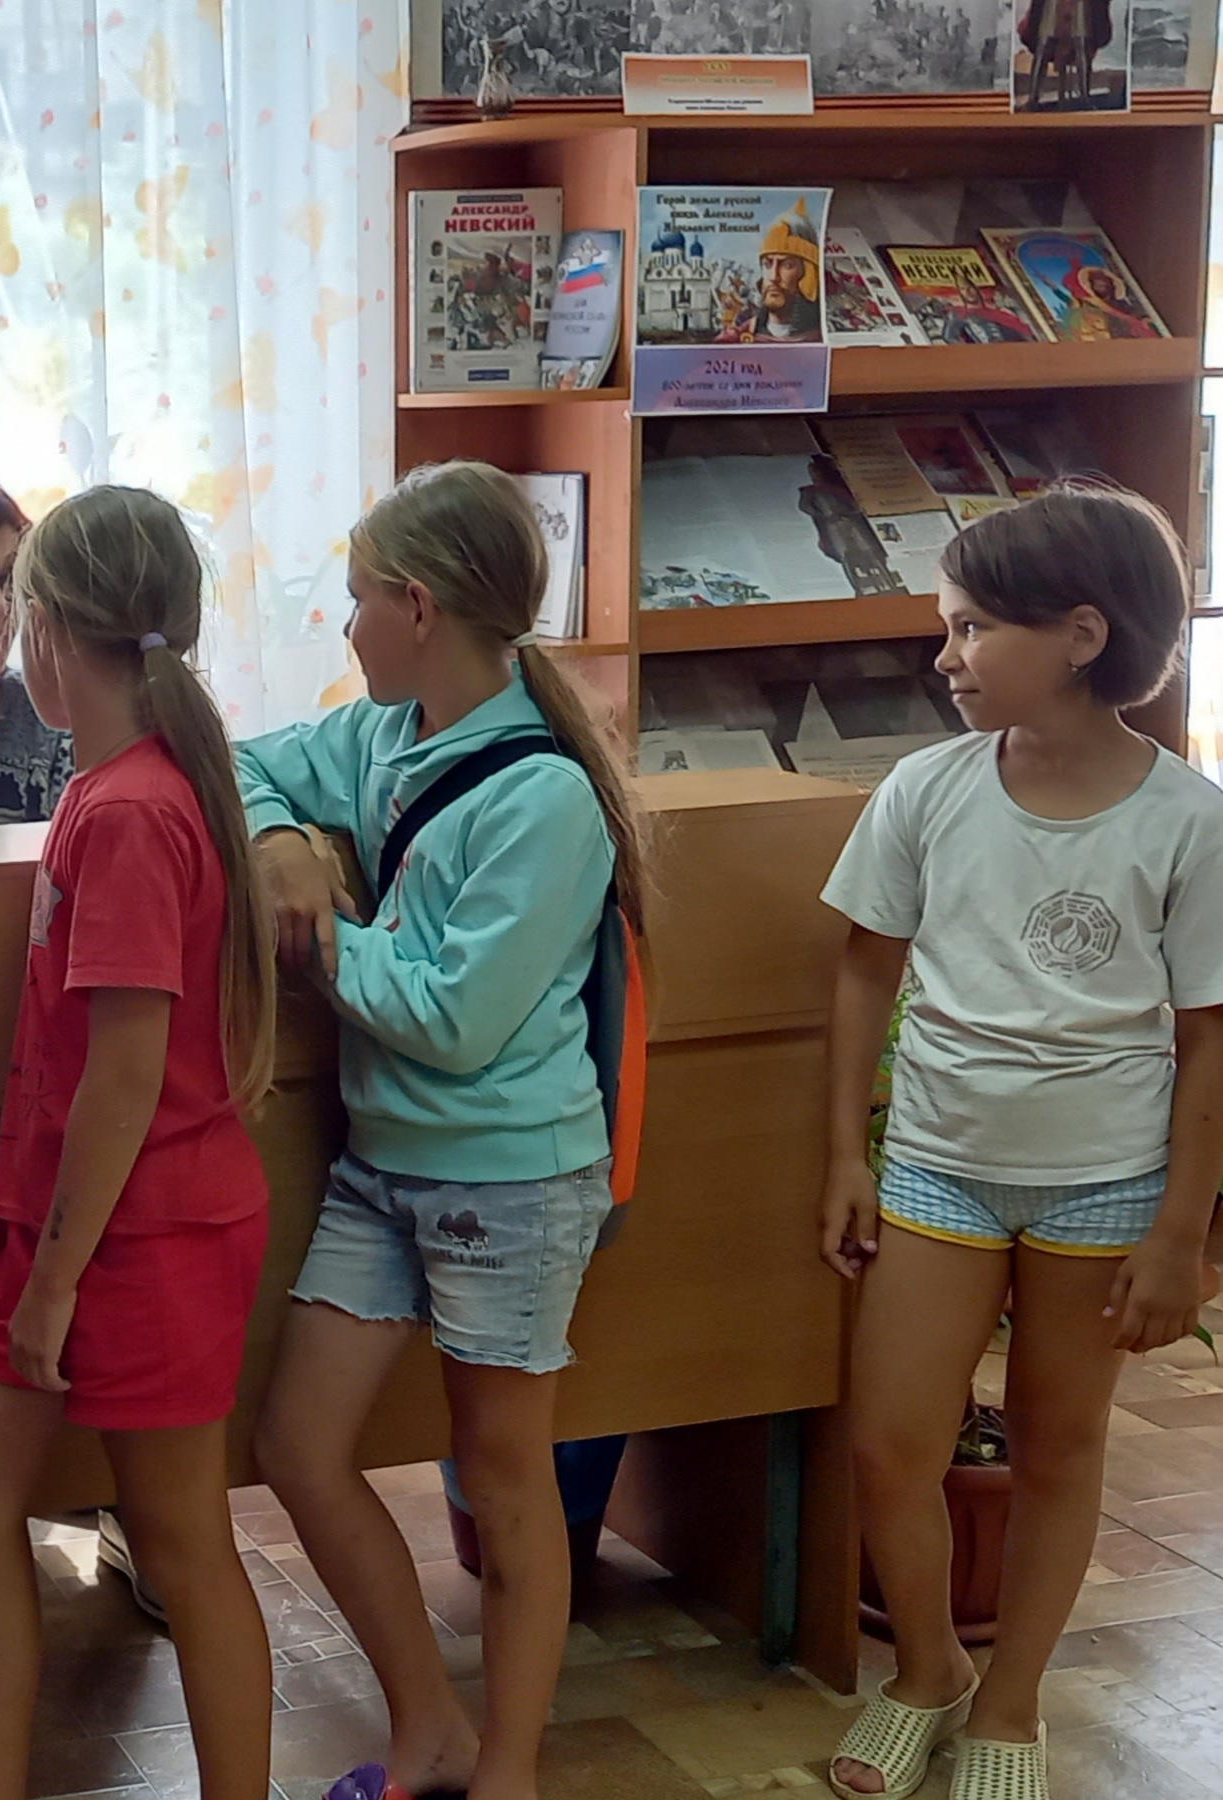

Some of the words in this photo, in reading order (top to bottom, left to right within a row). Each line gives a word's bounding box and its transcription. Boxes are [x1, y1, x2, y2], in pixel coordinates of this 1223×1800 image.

[451, 205, 529, 216] АЛЕКСАНДР
[444, 217, 536, 233] НЕВСКИЙ
[901, 262, 986, 283] НЕВСКИЙ
[704, 360, 736, 374] 2021
[741, 364, 763, 376] год
